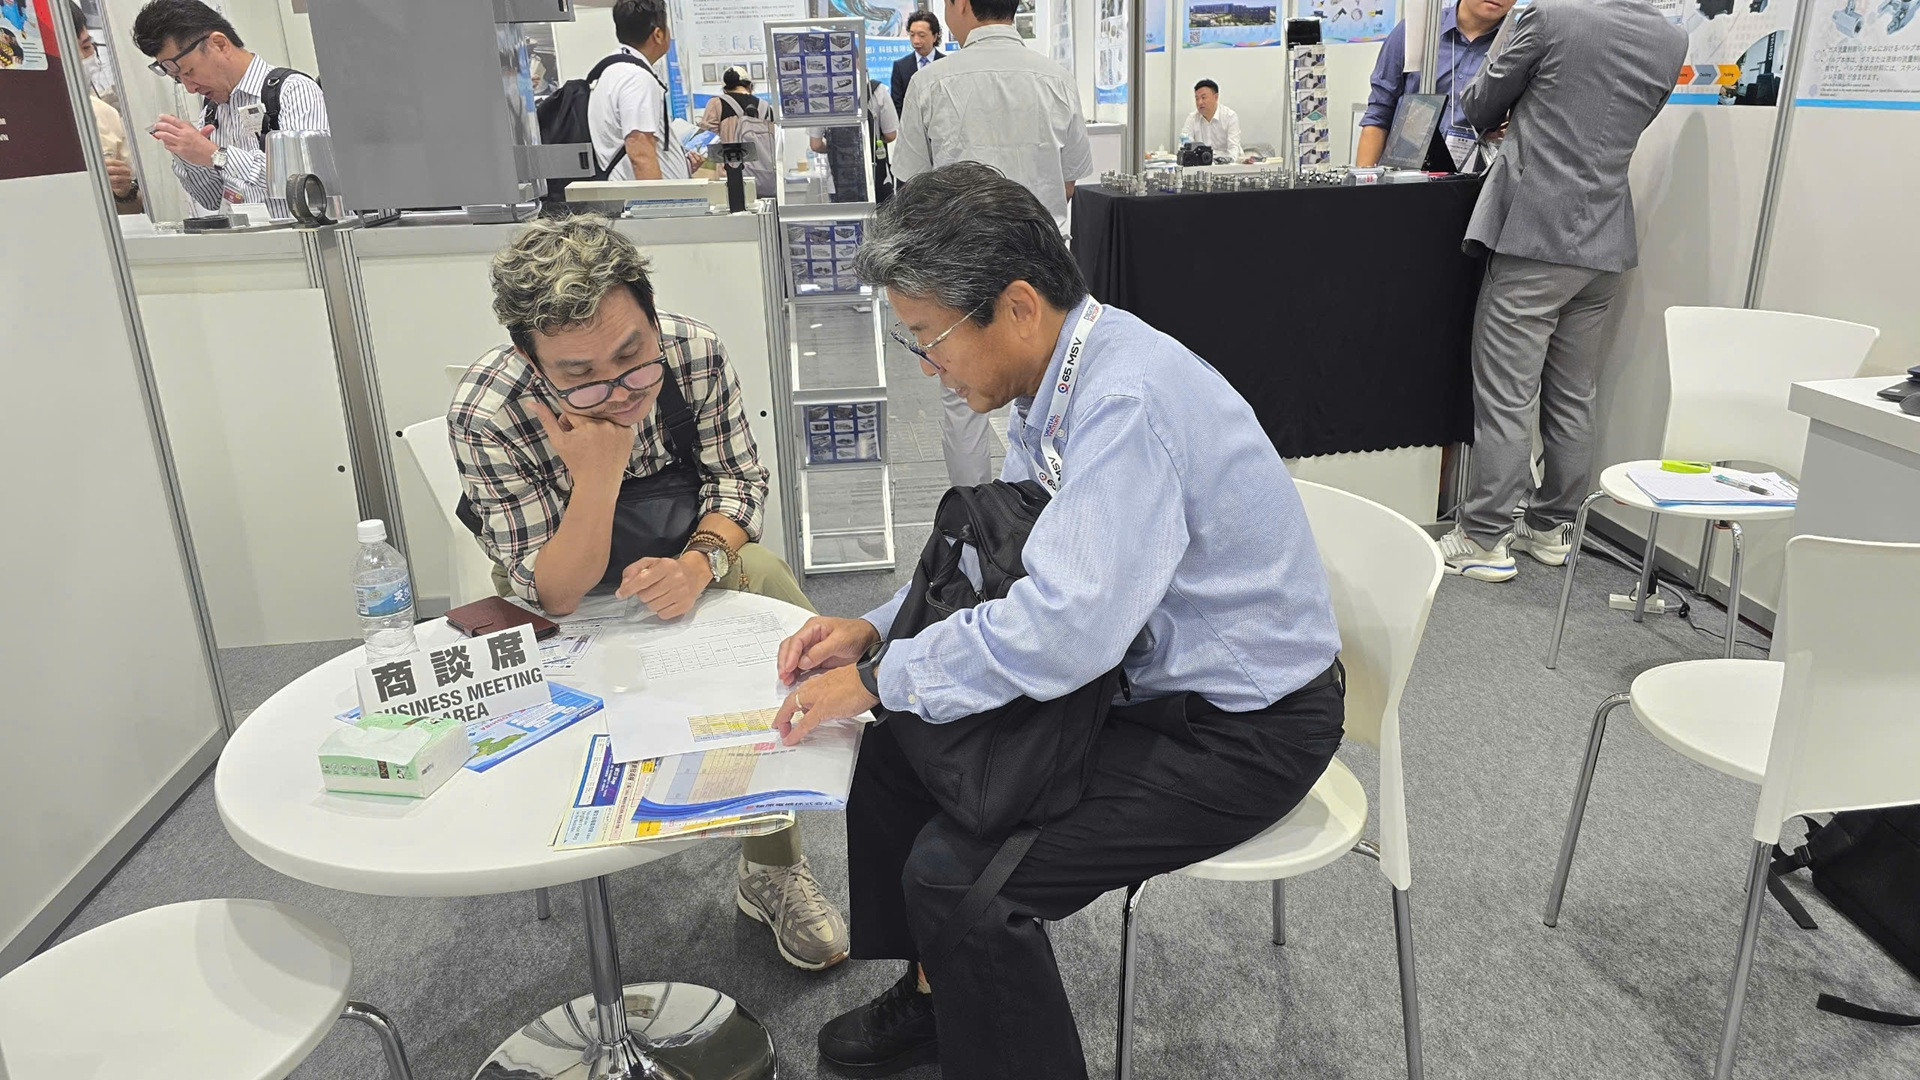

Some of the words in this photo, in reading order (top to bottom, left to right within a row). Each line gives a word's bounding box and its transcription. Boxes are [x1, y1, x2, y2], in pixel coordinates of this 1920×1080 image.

[1067, 337, 1083, 366] MSV
[371, 630, 527, 703] 商談席
[375, 690, 463, 716] SINESS
[467, 667, 543, 701] MEETING
